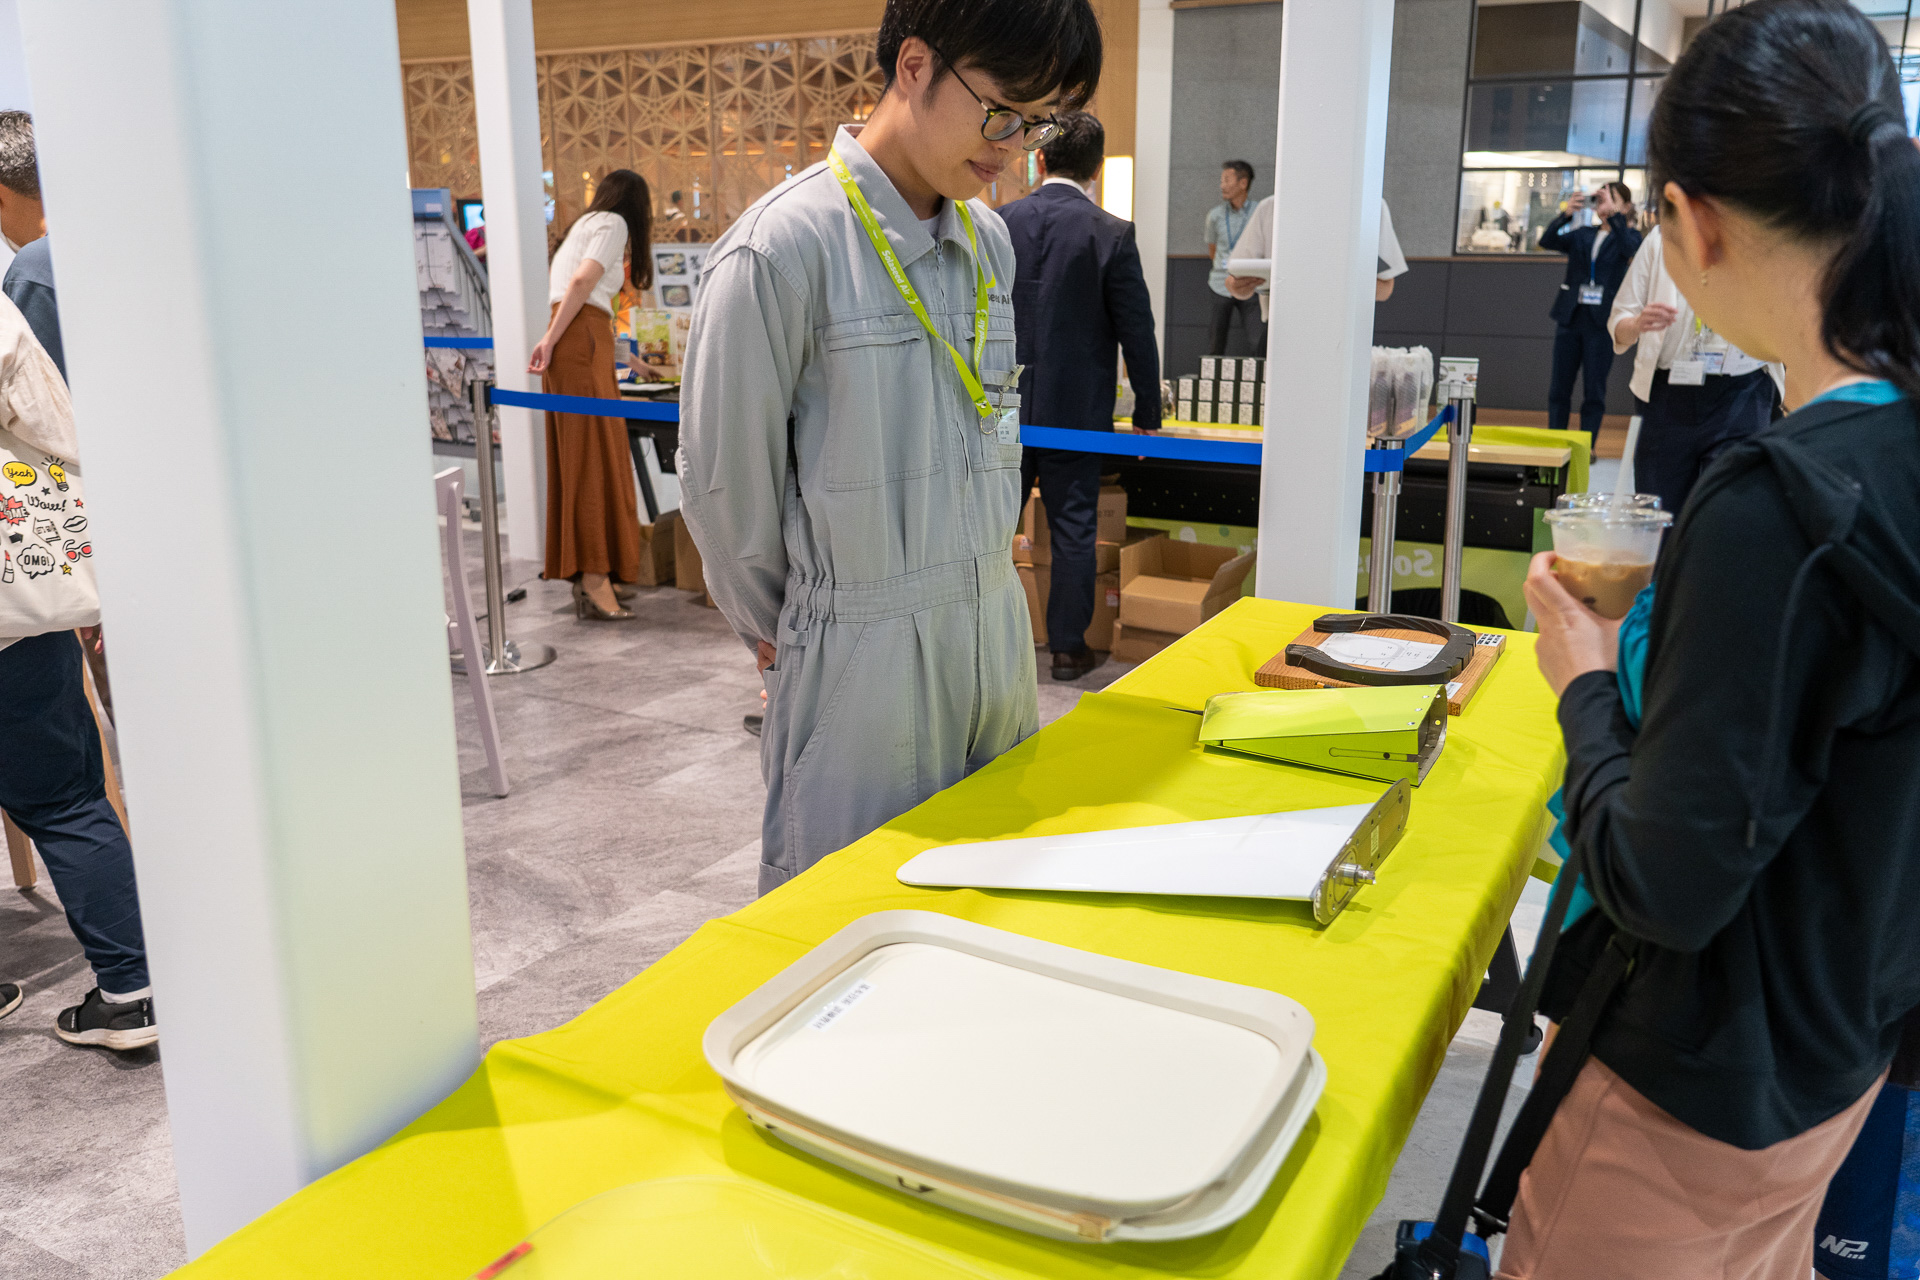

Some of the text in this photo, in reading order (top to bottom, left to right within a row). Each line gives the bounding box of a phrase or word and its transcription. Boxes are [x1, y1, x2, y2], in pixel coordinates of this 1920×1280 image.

[881, 249, 911, 295] Solaseed Air
[977, 319, 986, 330] Air
[6, 467, 33, 479] Yeah
[23, 554, 51, 567] OMG!
